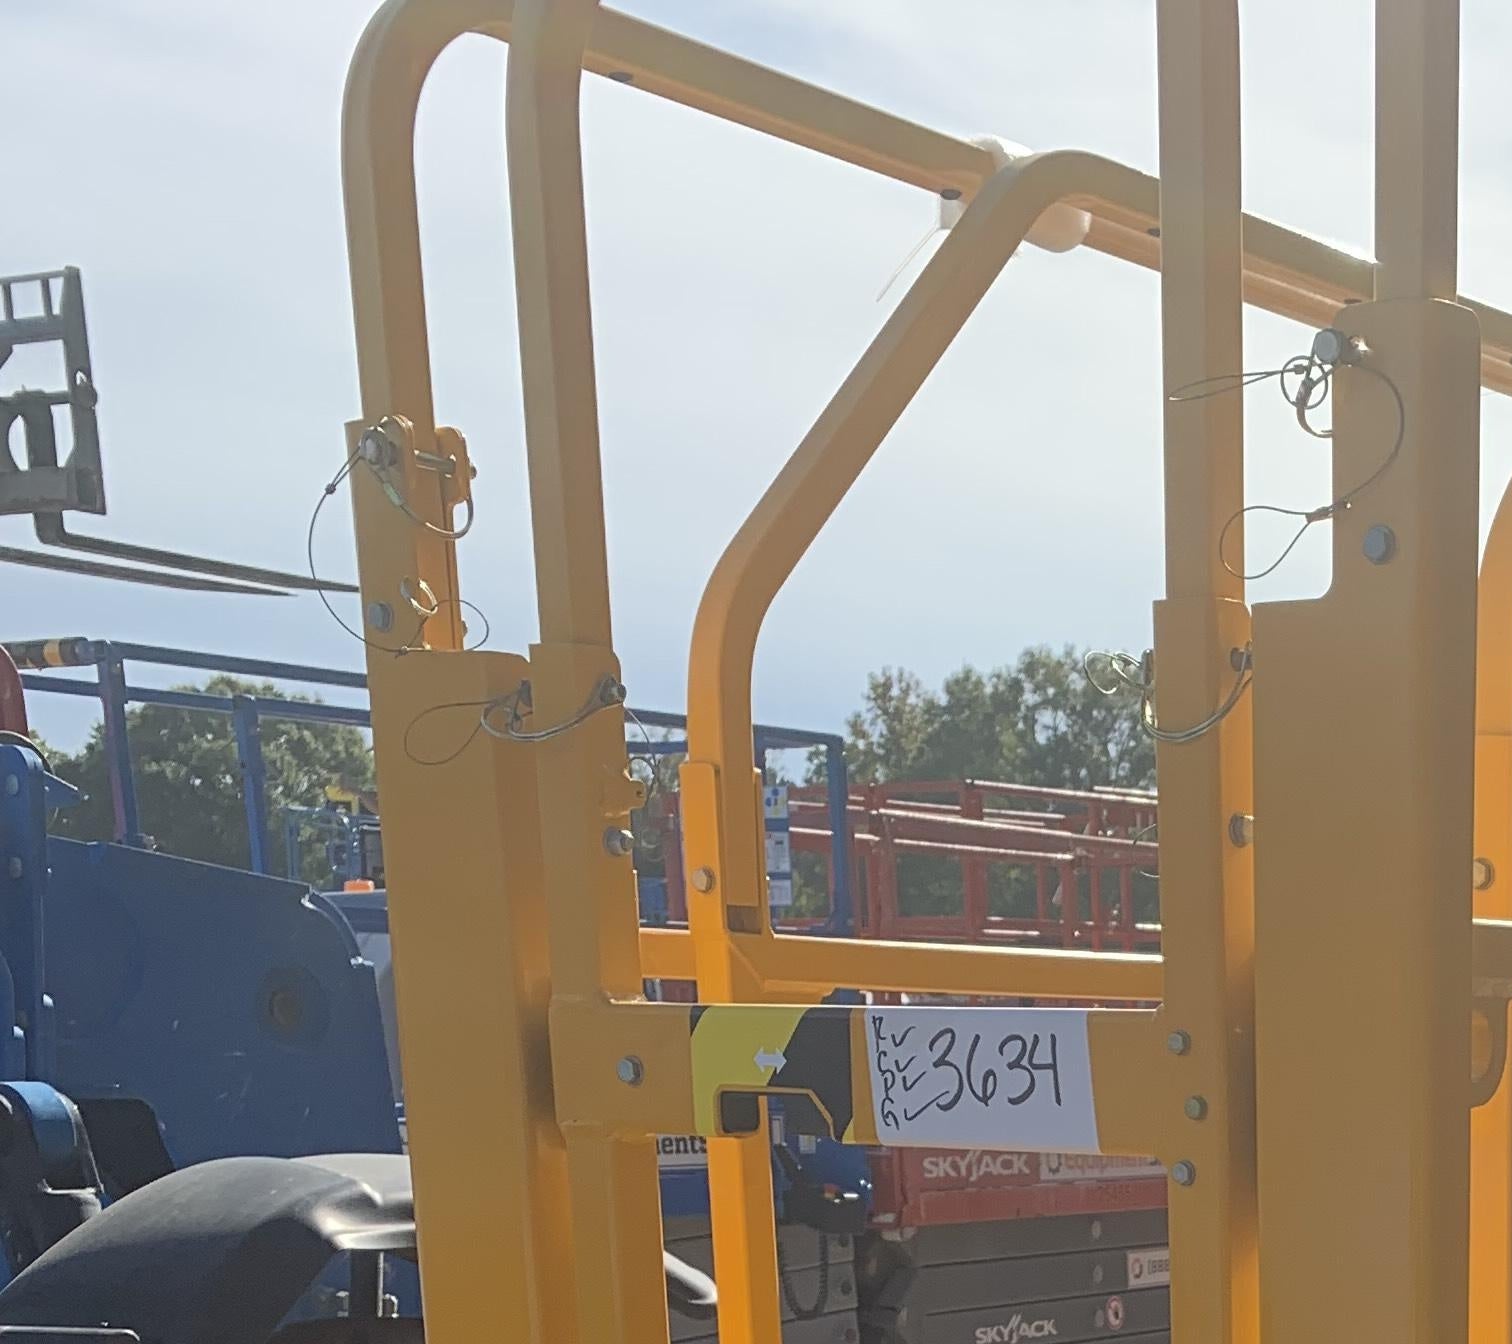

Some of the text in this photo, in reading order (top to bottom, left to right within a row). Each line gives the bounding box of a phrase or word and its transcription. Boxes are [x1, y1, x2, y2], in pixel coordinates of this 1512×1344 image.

[928, 1027, 1062, 1112] 3634
[923, 1149, 1030, 1181] SKYJACK
[975, 1312, 1058, 1344] SKYJACK
